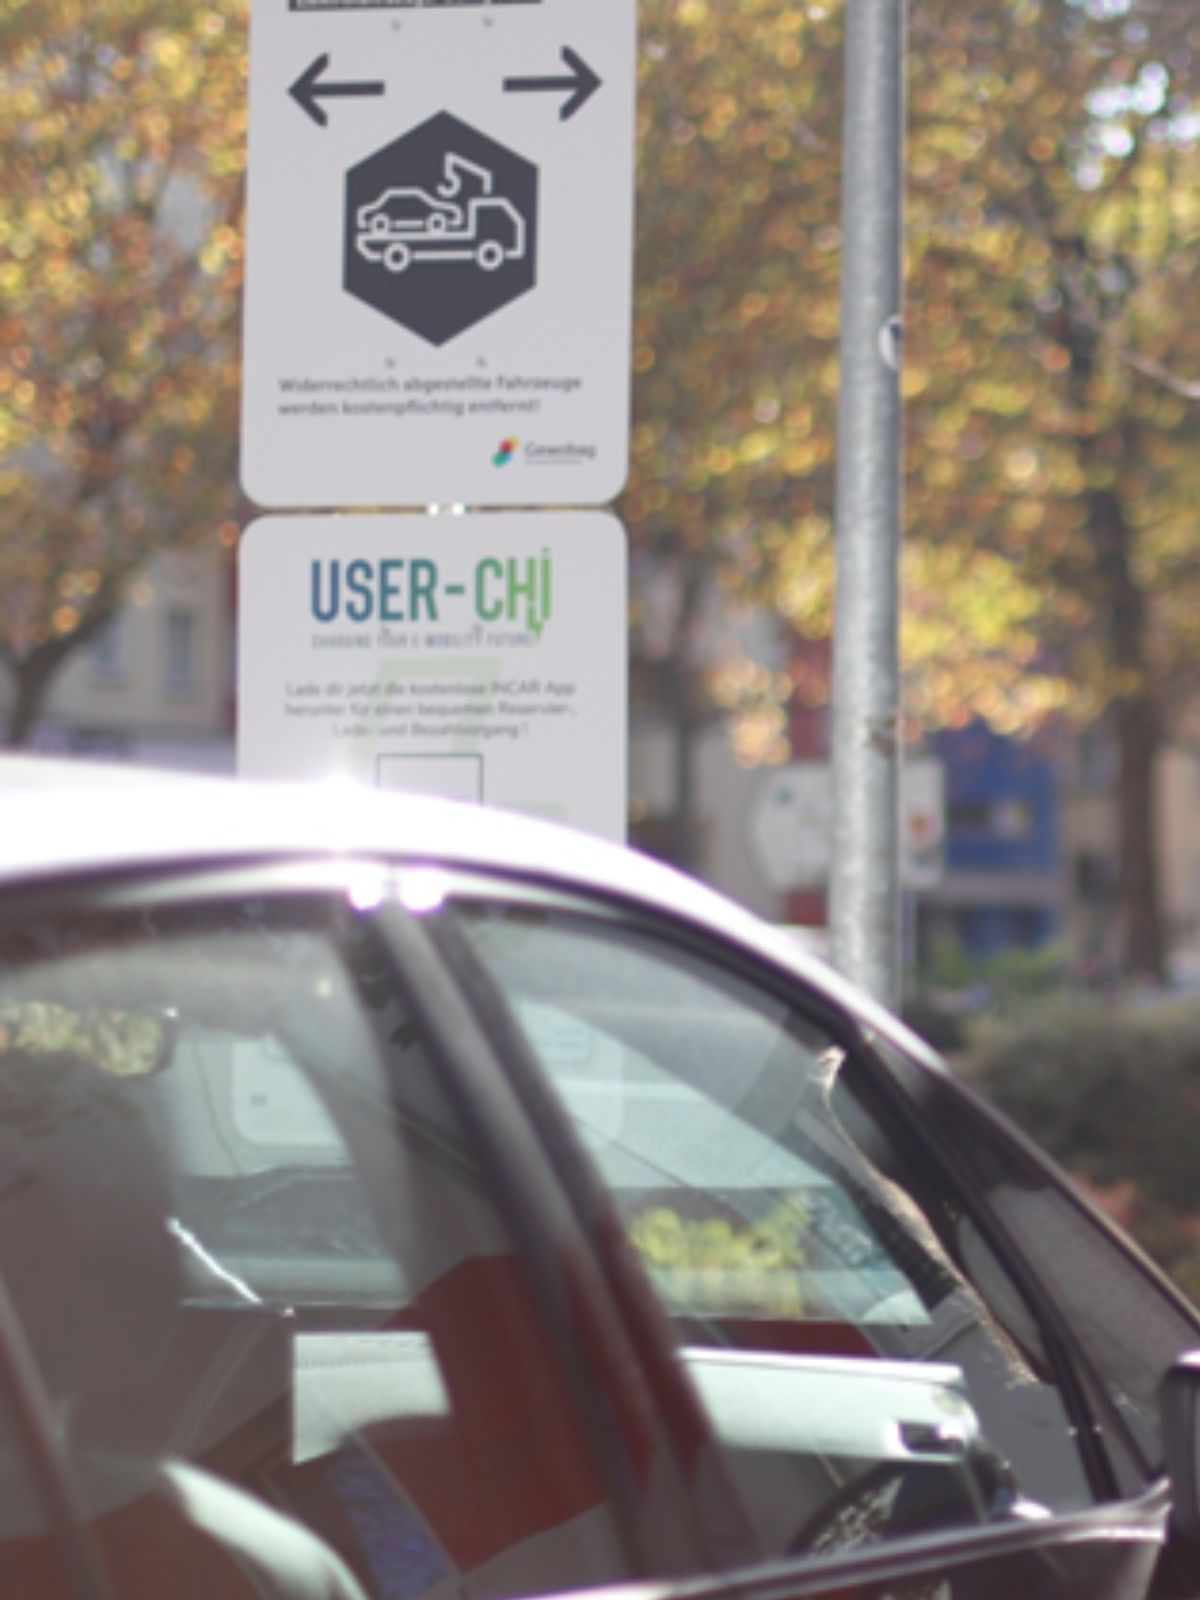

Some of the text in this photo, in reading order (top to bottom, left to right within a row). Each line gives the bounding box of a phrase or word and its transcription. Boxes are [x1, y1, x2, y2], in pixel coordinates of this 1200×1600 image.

[403, 376, 492, 395] abgestellte
[497, 374, 582, 393] Fahrzeuge
[278, 400, 338, 415] werden
[544, 679, 576, 697] App
